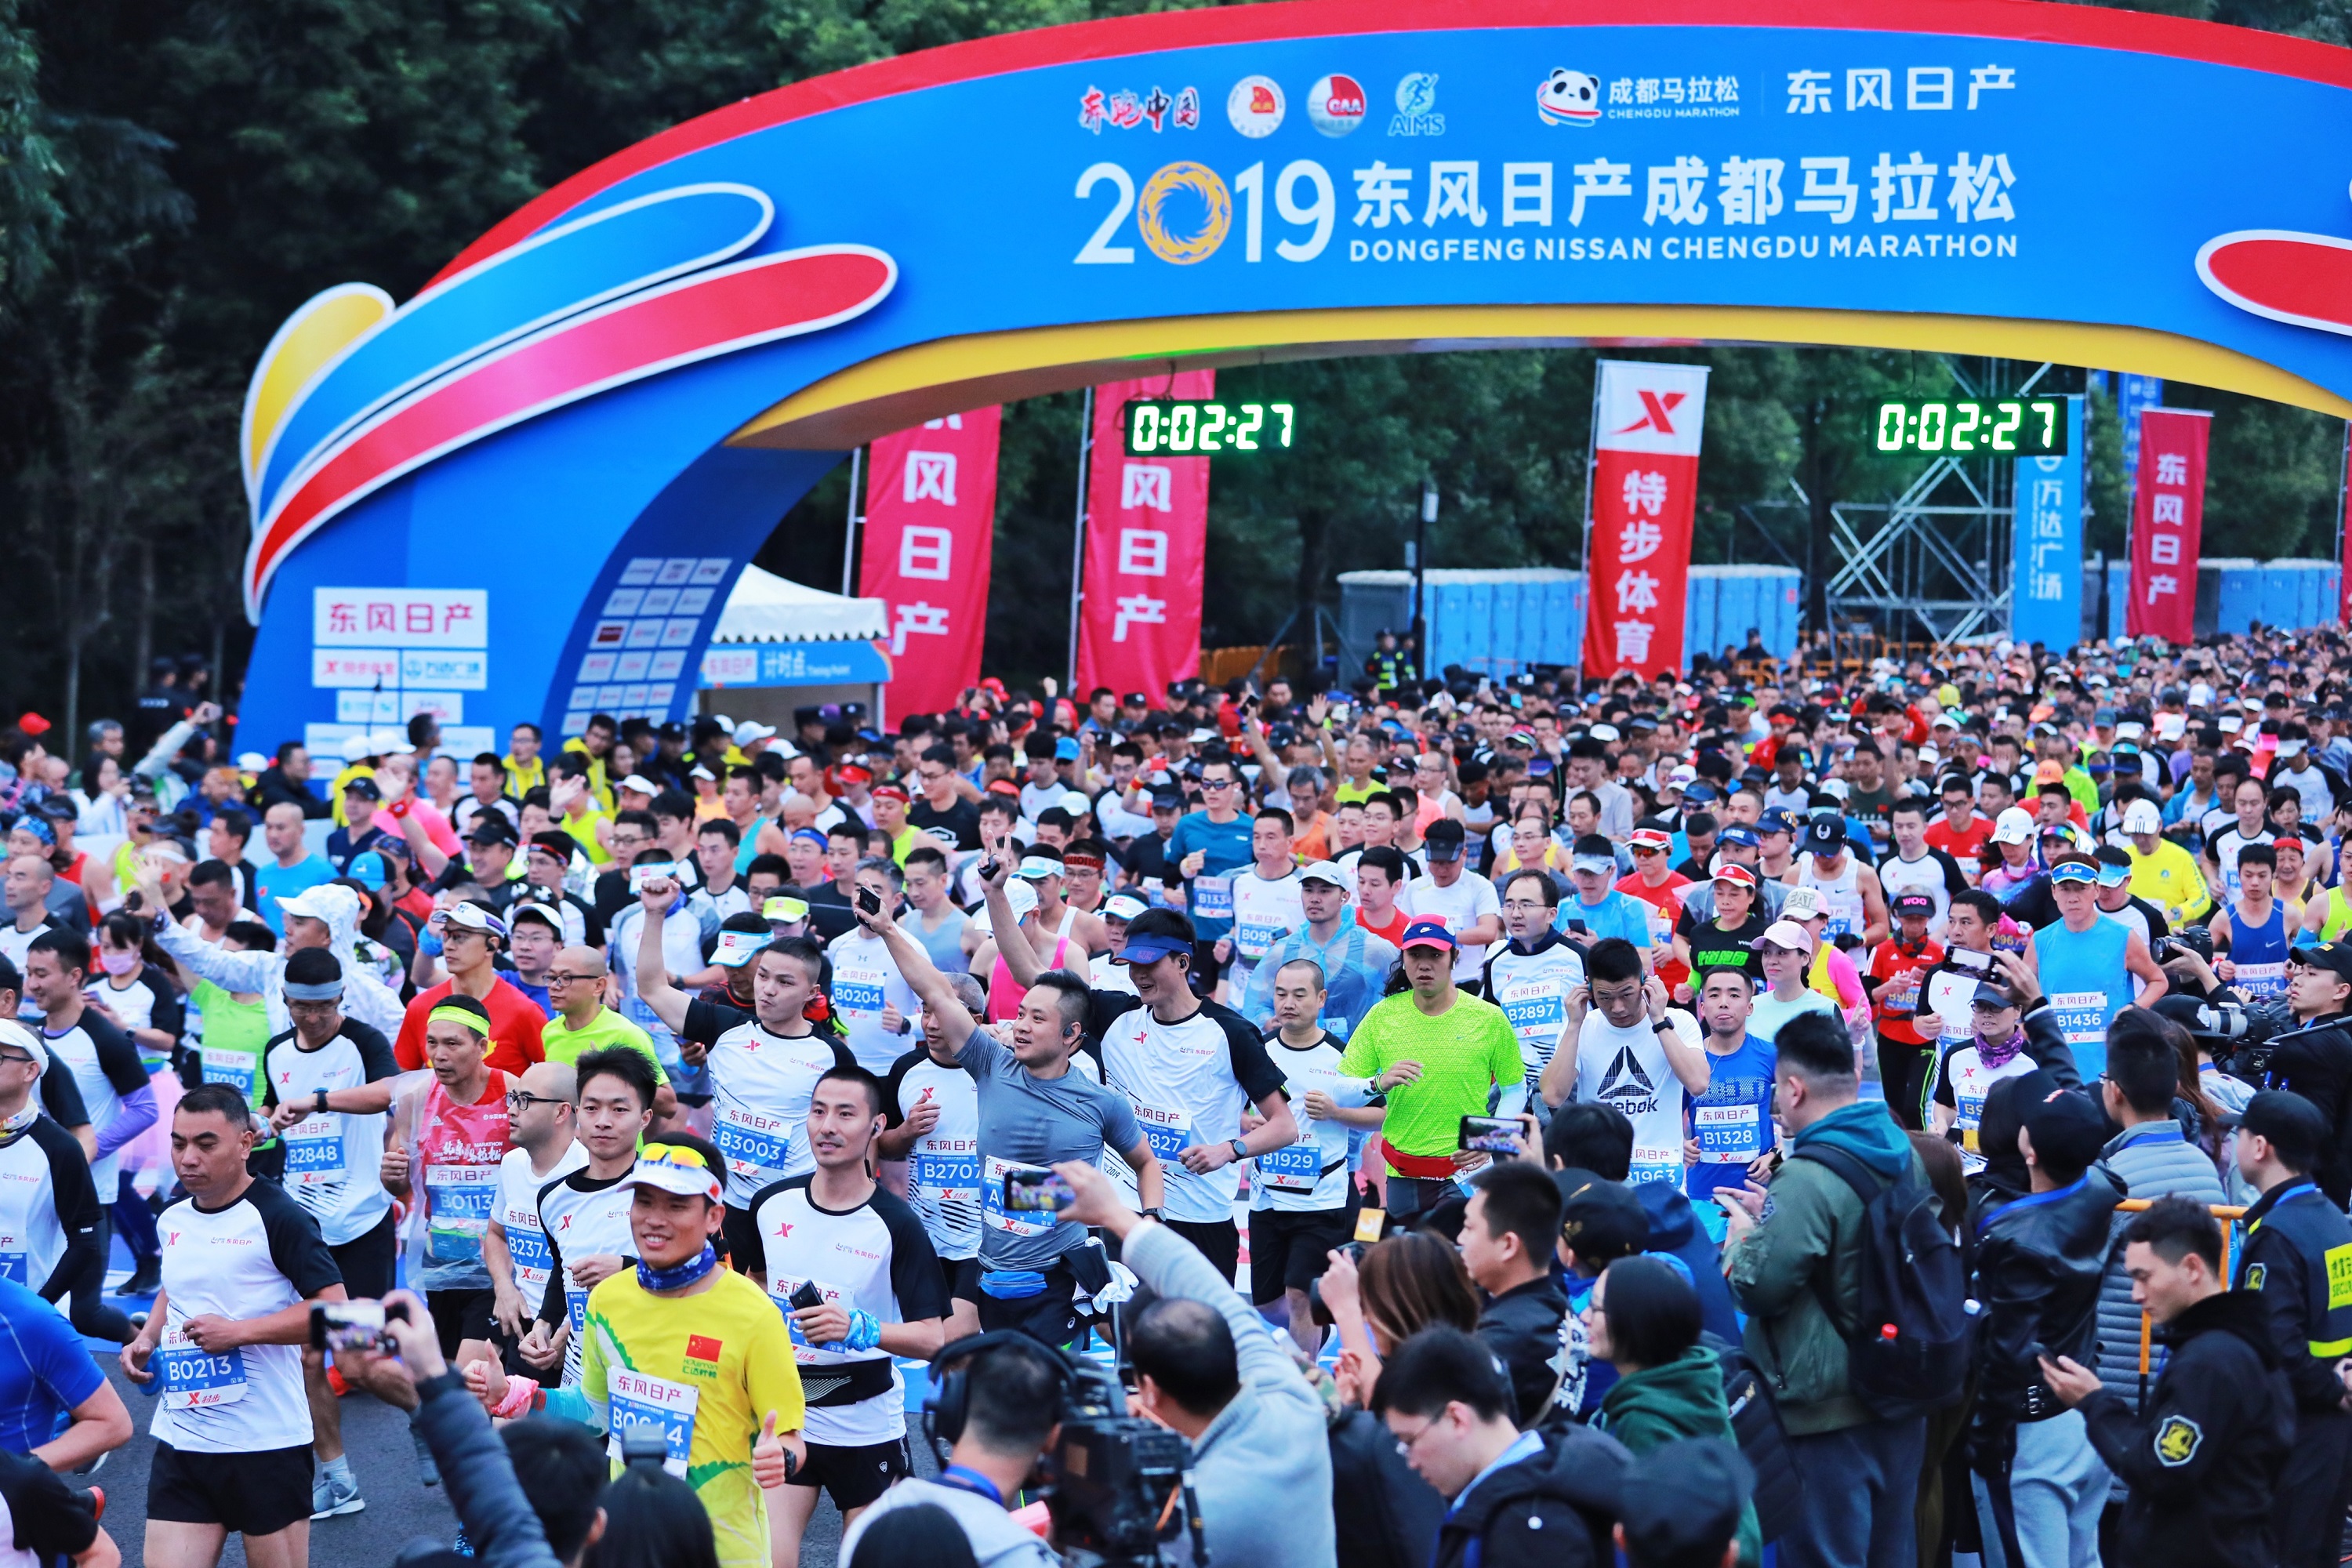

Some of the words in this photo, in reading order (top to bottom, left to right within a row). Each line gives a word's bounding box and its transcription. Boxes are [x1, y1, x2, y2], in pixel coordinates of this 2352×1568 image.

[1609, 75, 1740, 104] 成都马拉松
[1787, 64, 2016, 114] 东风日产
[1080, 85, 1200, 134] 奔跑中国
[1327, 98, 1365, 116] CAA
[1608, 108, 1671, 119] CHENGDU
[1675, 106, 1739, 118] MARATHON
[1388, 113, 1445, 136] AIMS
[1073, 159, 1336, 265] 2019
[1352, 152, 2016, 229] 东风日产成都马拉松
[1350, 238, 1525, 261] DONGFENG
[1535, 238, 1652, 260] NISSAN
[1661, 236, 1819, 259] CHENGDU
[1830, 235, 2017, 257] MARATHON
[1132, 403, 1294, 452] 0:02:27
[1876, 402, 2057, 452] 0:02:27
[891, 412, 962, 656] 风日产
[2147, 452, 2187, 606] 东风日产
[2036, 479, 2063, 601] 万达广场
[1112, 463, 1171, 642] 风日产
[1613, 470, 1668, 664] 特步体育
[330, 603, 473, 634] 东风日产
[1242, 928, 1272, 941] B099
[1820, 924, 1846, 935] 047
[834, 987, 881, 1004] B0204
[1510, 984, 1552, 999] 东风日产
[2057, 995, 2098, 1006] 东风日产
[1508, 1004, 1555, 1022] B2897
[2056, 1013, 2102, 1027] B1436
[1945, 1025, 1974, 1035] 东风日
[1134, 1104, 1181, 1123] 东风日产
[1607, 1097, 1659, 1116] ebok
[1703, 1109, 1750, 1121] 东风日产
[289, 1121, 331, 1136] 东风日产
[729, 1109, 782, 1131] 东风日产
[719, 1130, 782, 1161] B3003
[926, 1139, 978, 1151] 东风日产
[1142, 1131, 1181, 1152] 827
[1704, 1129, 1754, 1145] B1328
[289, 1145, 338, 1164] B2848
[1262, 1152, 1313, 1169] B1929
[1630, 1149, 1670, 1160] 风日产
[437, 1169, 492, 1181] 东风日产
[924, 1163, 981, 1179] B2707
[1106, 1166, 1120, 1178] 2019
[440, 1194, 492, 1210] B0113
[509, 1210, 538, 1227] 东风日
[854, 1249, 880, 1260] 东风日产
[169, 1355, 233, 1381] B0213
[619, 1375, 682, 1403] 东风日产
[613, 1405, 684, 1448] B04
